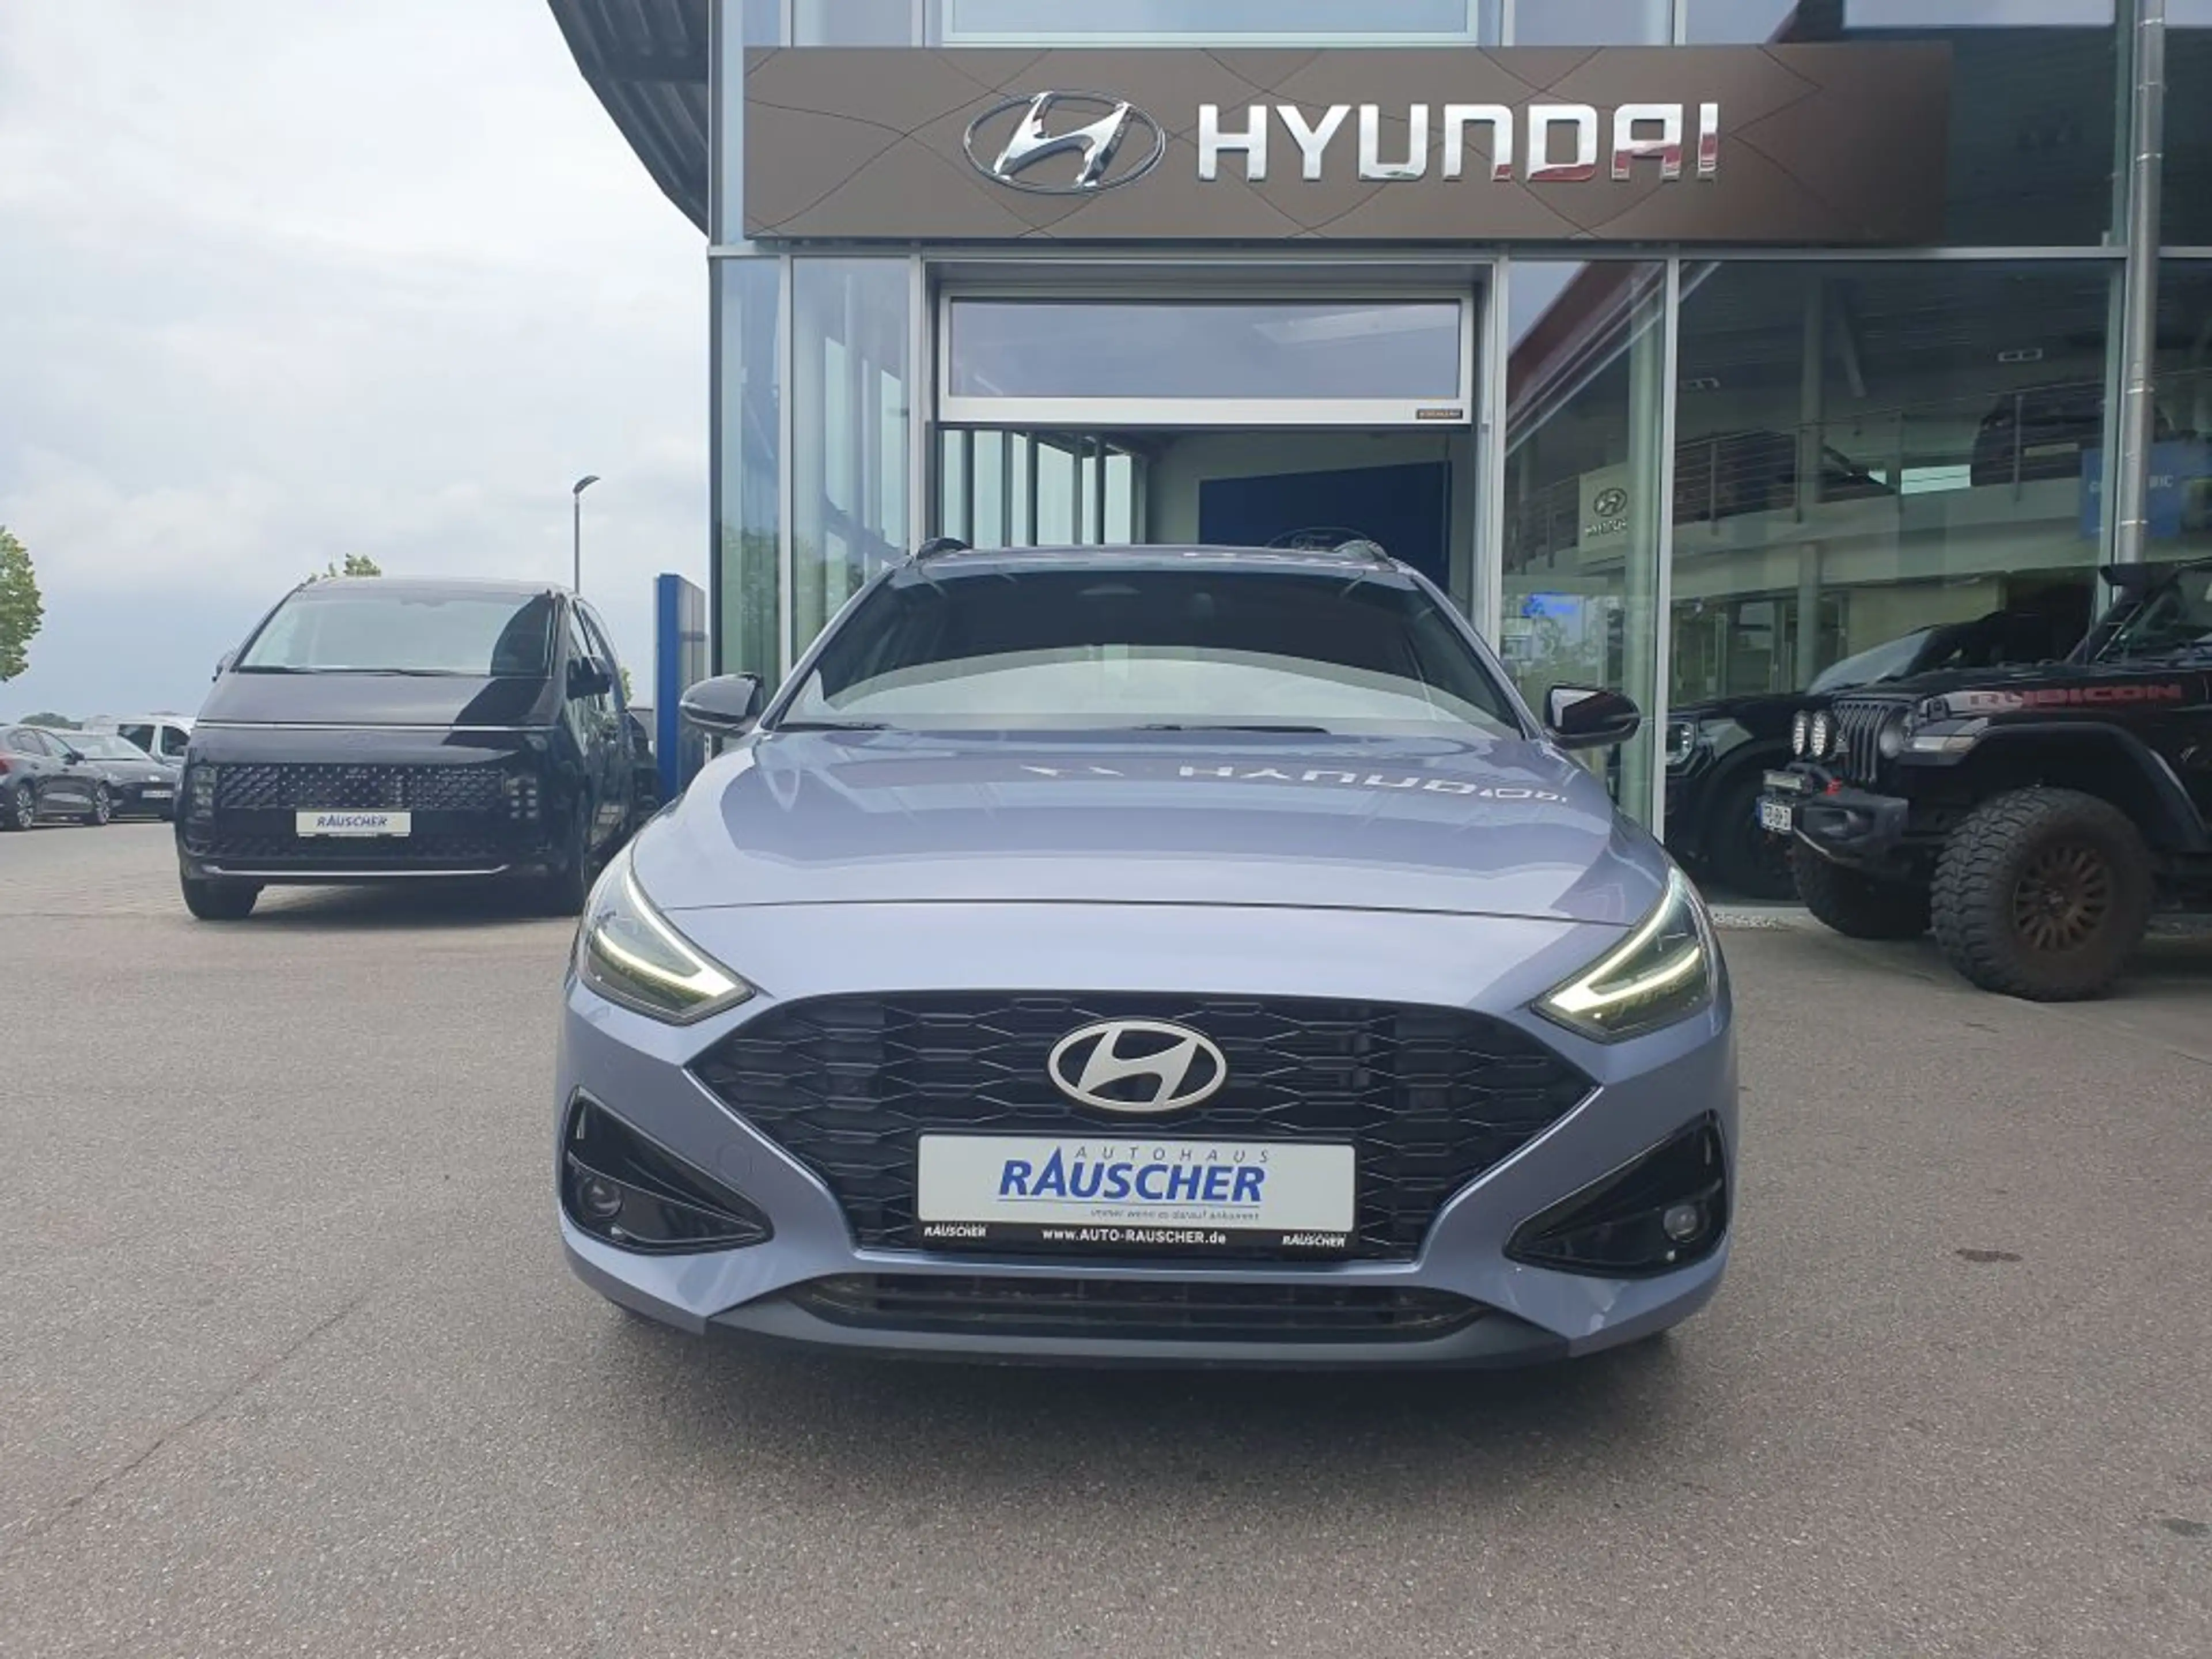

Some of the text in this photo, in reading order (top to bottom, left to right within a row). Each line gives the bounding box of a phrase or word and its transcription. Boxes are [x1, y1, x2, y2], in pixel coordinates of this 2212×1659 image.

[1198, 103, 1719, 182] HYUNDAI
[1969, 685, 2181, 709] RUBICON
[317, 814, 388, 827] RAUSCHER
[1074, 1146, 1270, 1164] AUTOHAUS
[999, 1146, 1266, 1202] RAUSCHER
[924, 1224, 987, 1238] RAUSCHER
[1041, 1228, 1226, 1245] www.AUTO-RAUSCHER.de
[1282, 1234, 1346, 1248] RAUSCHER
